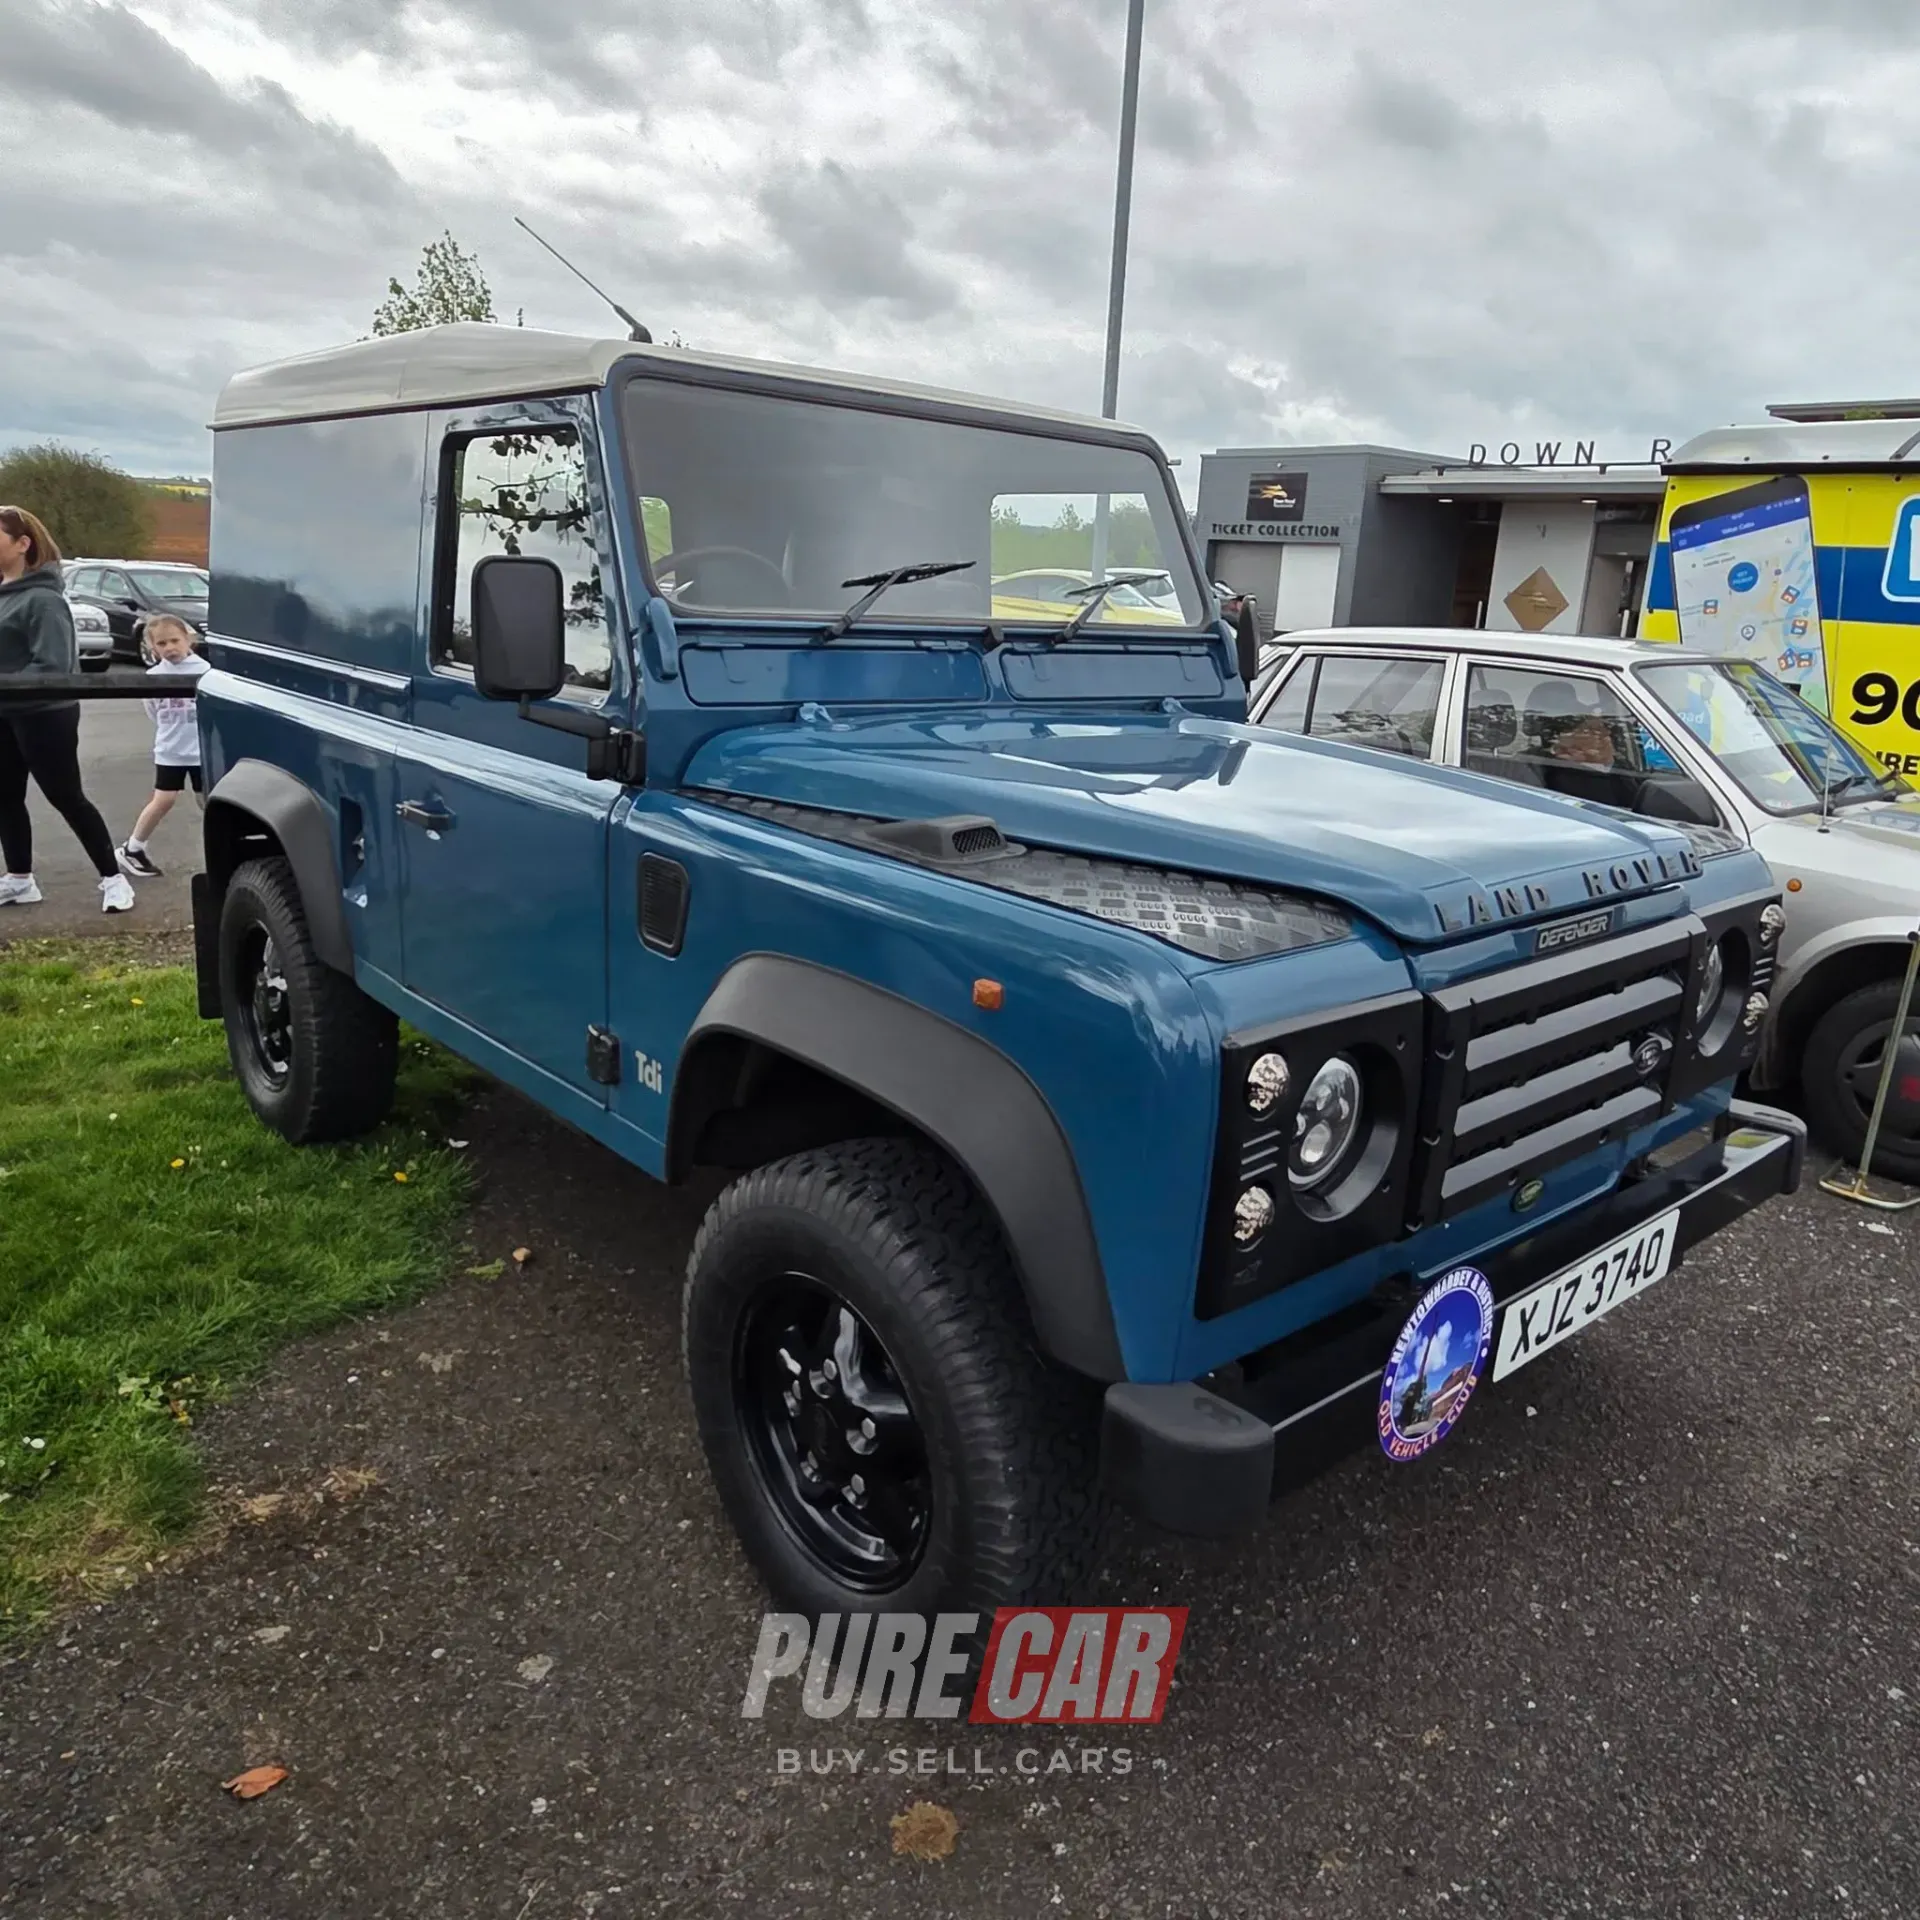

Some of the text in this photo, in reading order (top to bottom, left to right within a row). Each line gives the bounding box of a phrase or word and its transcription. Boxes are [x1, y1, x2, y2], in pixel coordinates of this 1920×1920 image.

[1468, 441, 1595, 467] DOWN
[1212, 523, 1340, 538] TICKET COLLECTION
[1433, 850, 1701, 933] LAND ROVER
[1538, 914, 1609, 949] DEFENDER
[634, 1050, 662, 1095] Tdi
[1509, 1228, 1665, 1363] XJZ 3740
[1379, 1374, 1478, 1458] OLD VEHICLE CLUB
